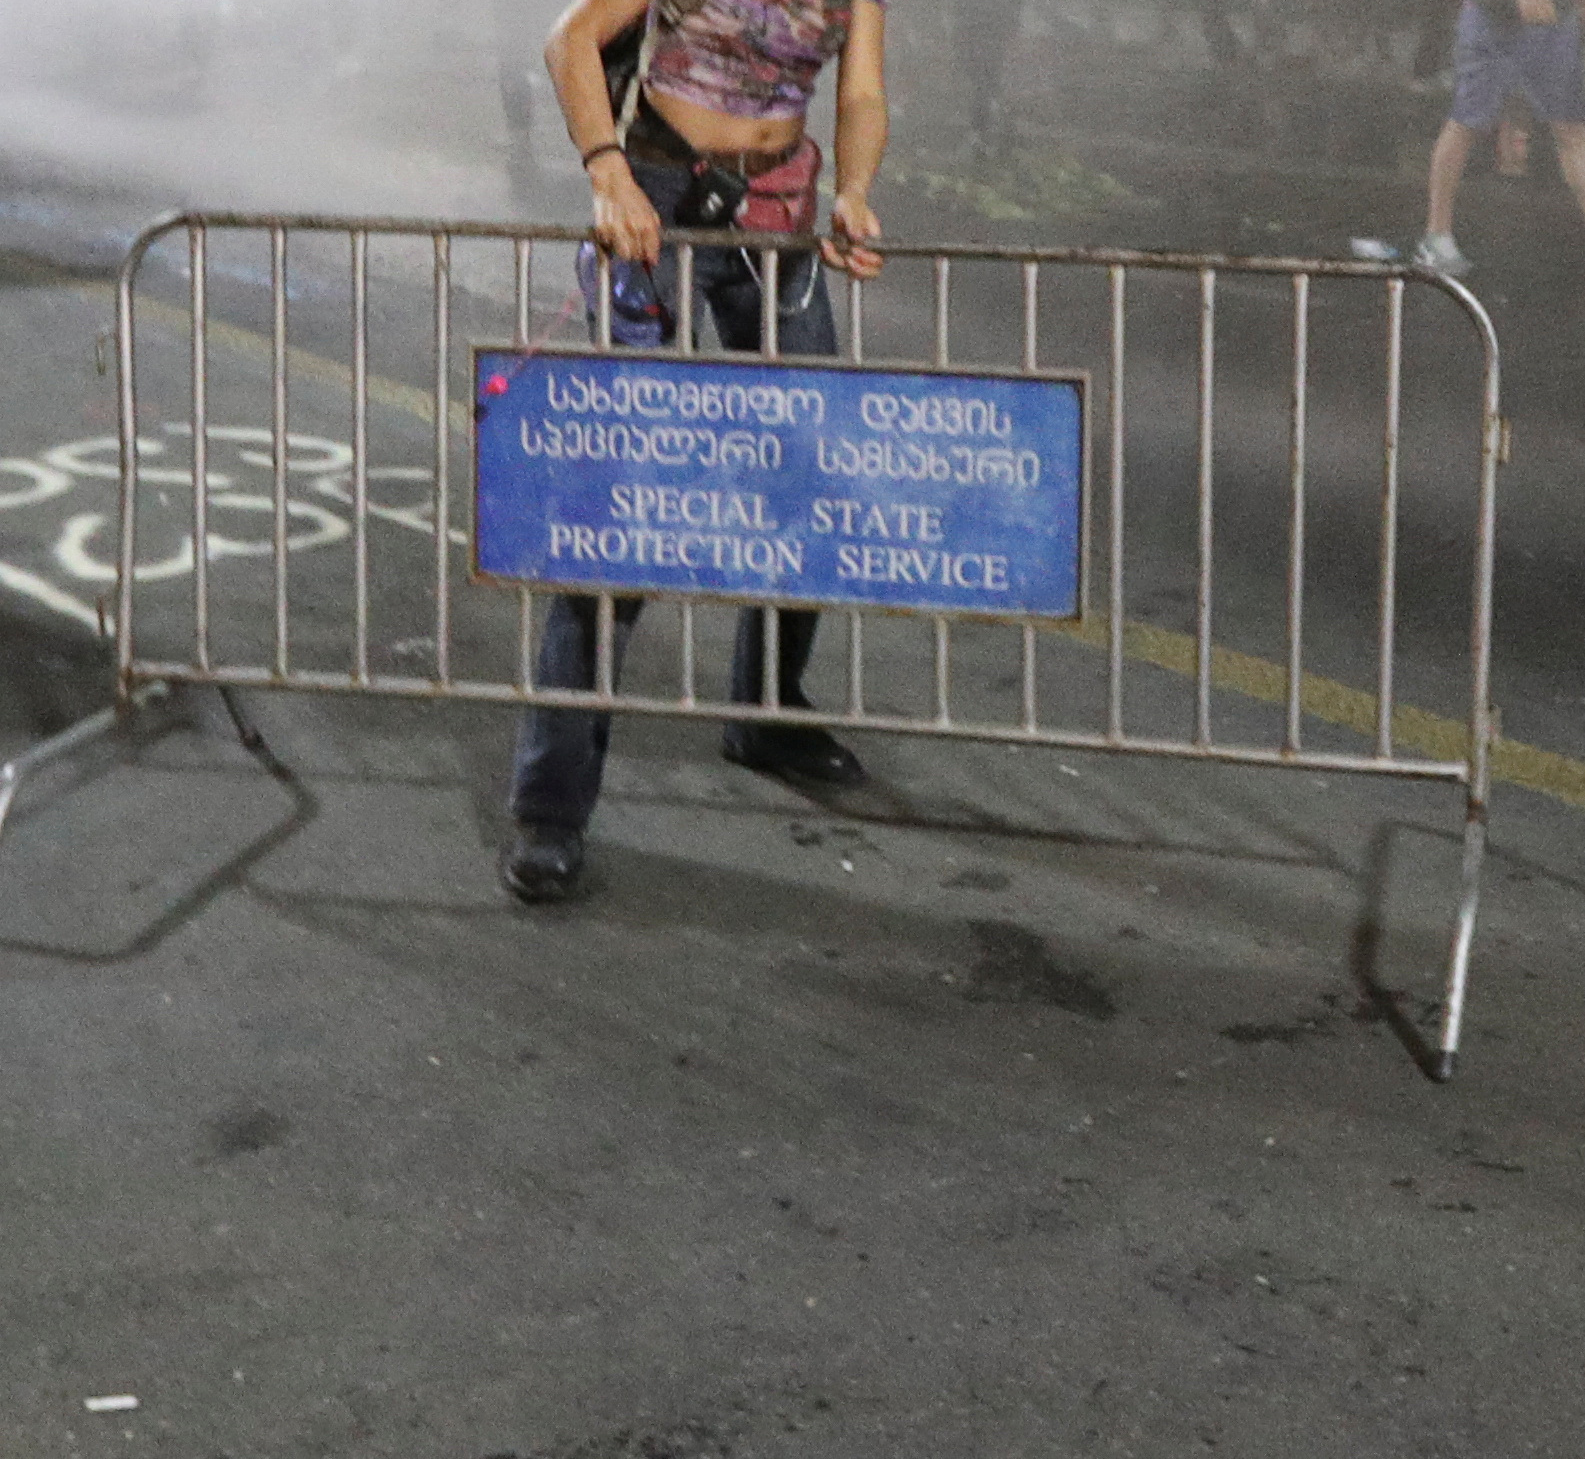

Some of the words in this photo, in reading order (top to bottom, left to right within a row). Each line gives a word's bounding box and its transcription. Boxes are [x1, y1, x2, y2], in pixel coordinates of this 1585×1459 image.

[548, 374, 826, 427] სახელმწიფო
[860, 393, 1011, 439] დაცვის
[521, 419, 781, 471] სპეციალური
[817, 436, 1039, 491] სამსახური
[610, 484, 777, 528] SPECIAL
[812, 499, 943, 543] STATE
[550, 523, 803, 574] PROTECTION
[838, 545, 1008, 590] SERVICE
